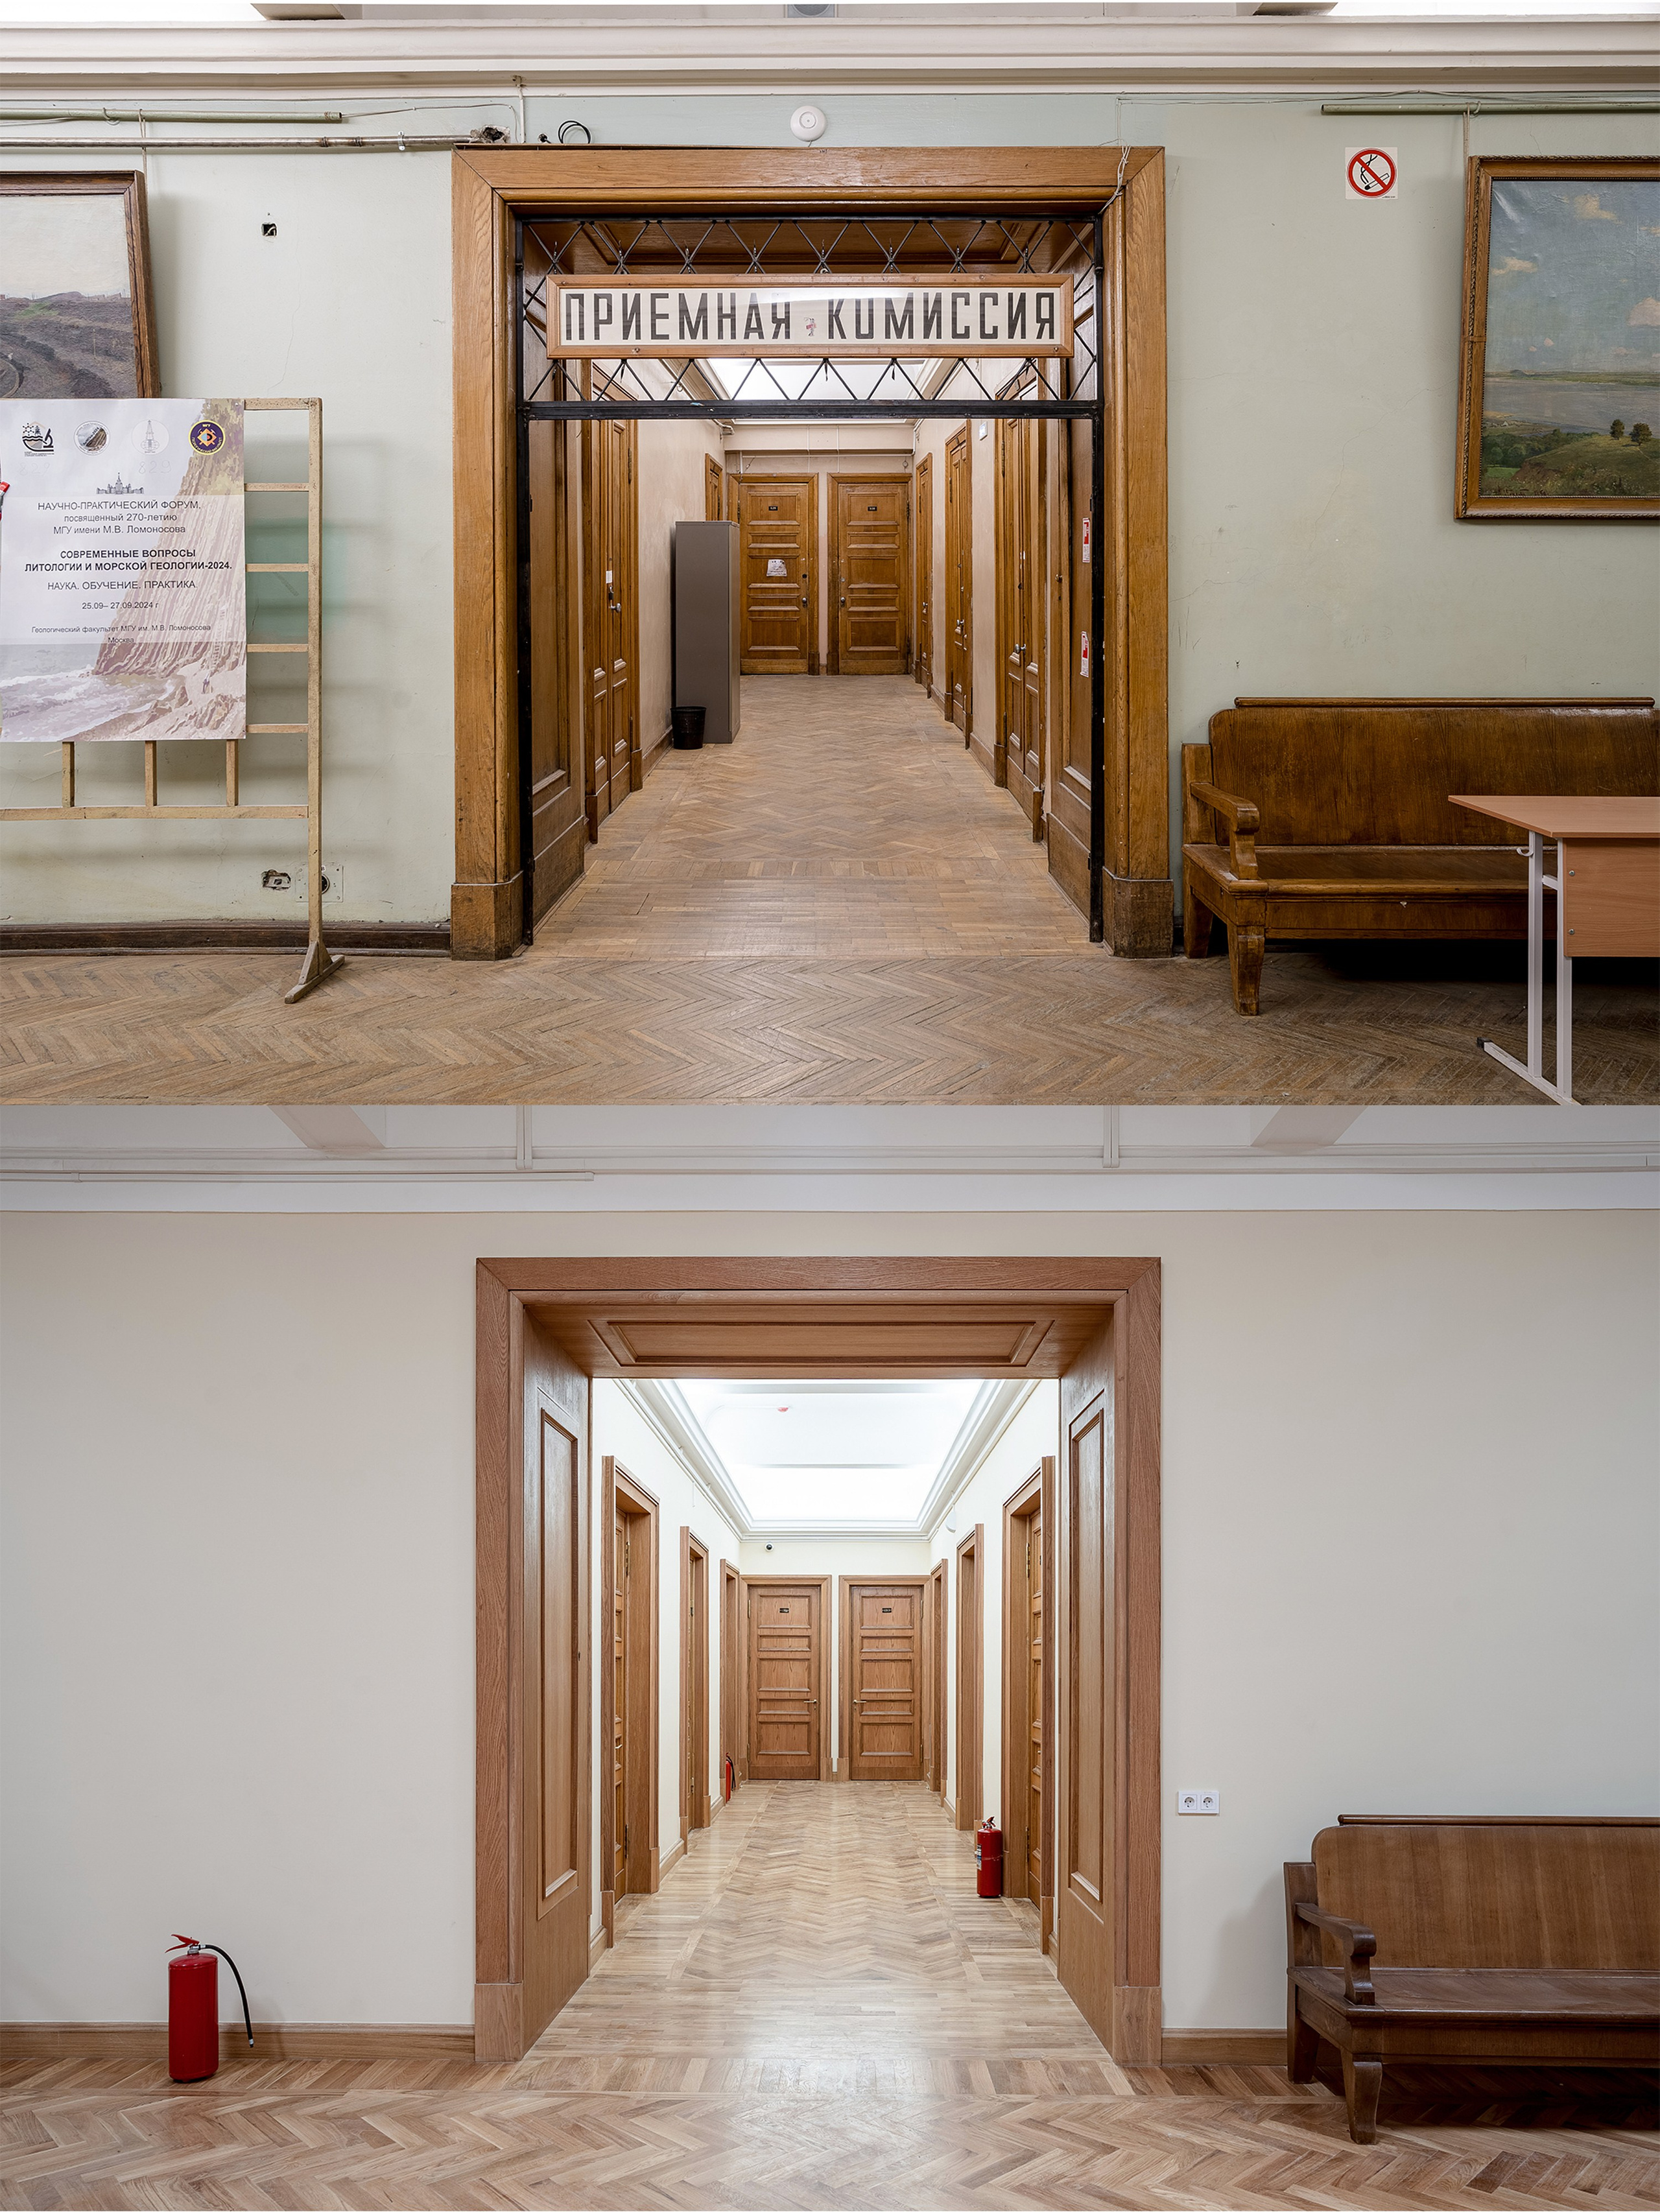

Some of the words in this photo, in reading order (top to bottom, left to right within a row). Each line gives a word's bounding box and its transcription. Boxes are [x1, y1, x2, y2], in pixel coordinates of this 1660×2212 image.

[565, 292, 791, 340] ПРИЕМНАЯ
[828, 292, 1055, 340] КОМИССИЯ
[138, 460, 172, 474] 829
[38, 500, 158, 510] НАУЧНО-ПРАКТИЧЕСКИЙ
[64, 513, 124, 523] посвященный
[126, 513, 178, 521] 270-летию
[103, 525, 124, 534] М.В.
[126, 525, 186, 534] Ломоносова
[60, 550, 139, 559] СОВРЕМЕННЫЕ
[142, 549, 196, 558] ВОПРОСЫ
[25, 563, 82, 572] ЛИТОЛОГИИ
[85, 563, 92, 571] И
[95, 561, 147, 571] МОРСКОЙ
[150, 561, 232, 570] ГЕОЛОГИИ-2024.
[47, 582, 80, 590] НАУКА.
[82, 581, 141, 590] ОБУЧЕНИЕ.
[144, 580, 198, 589] ПРАКТИКА.
[82, 625, 119, 634] факультет
